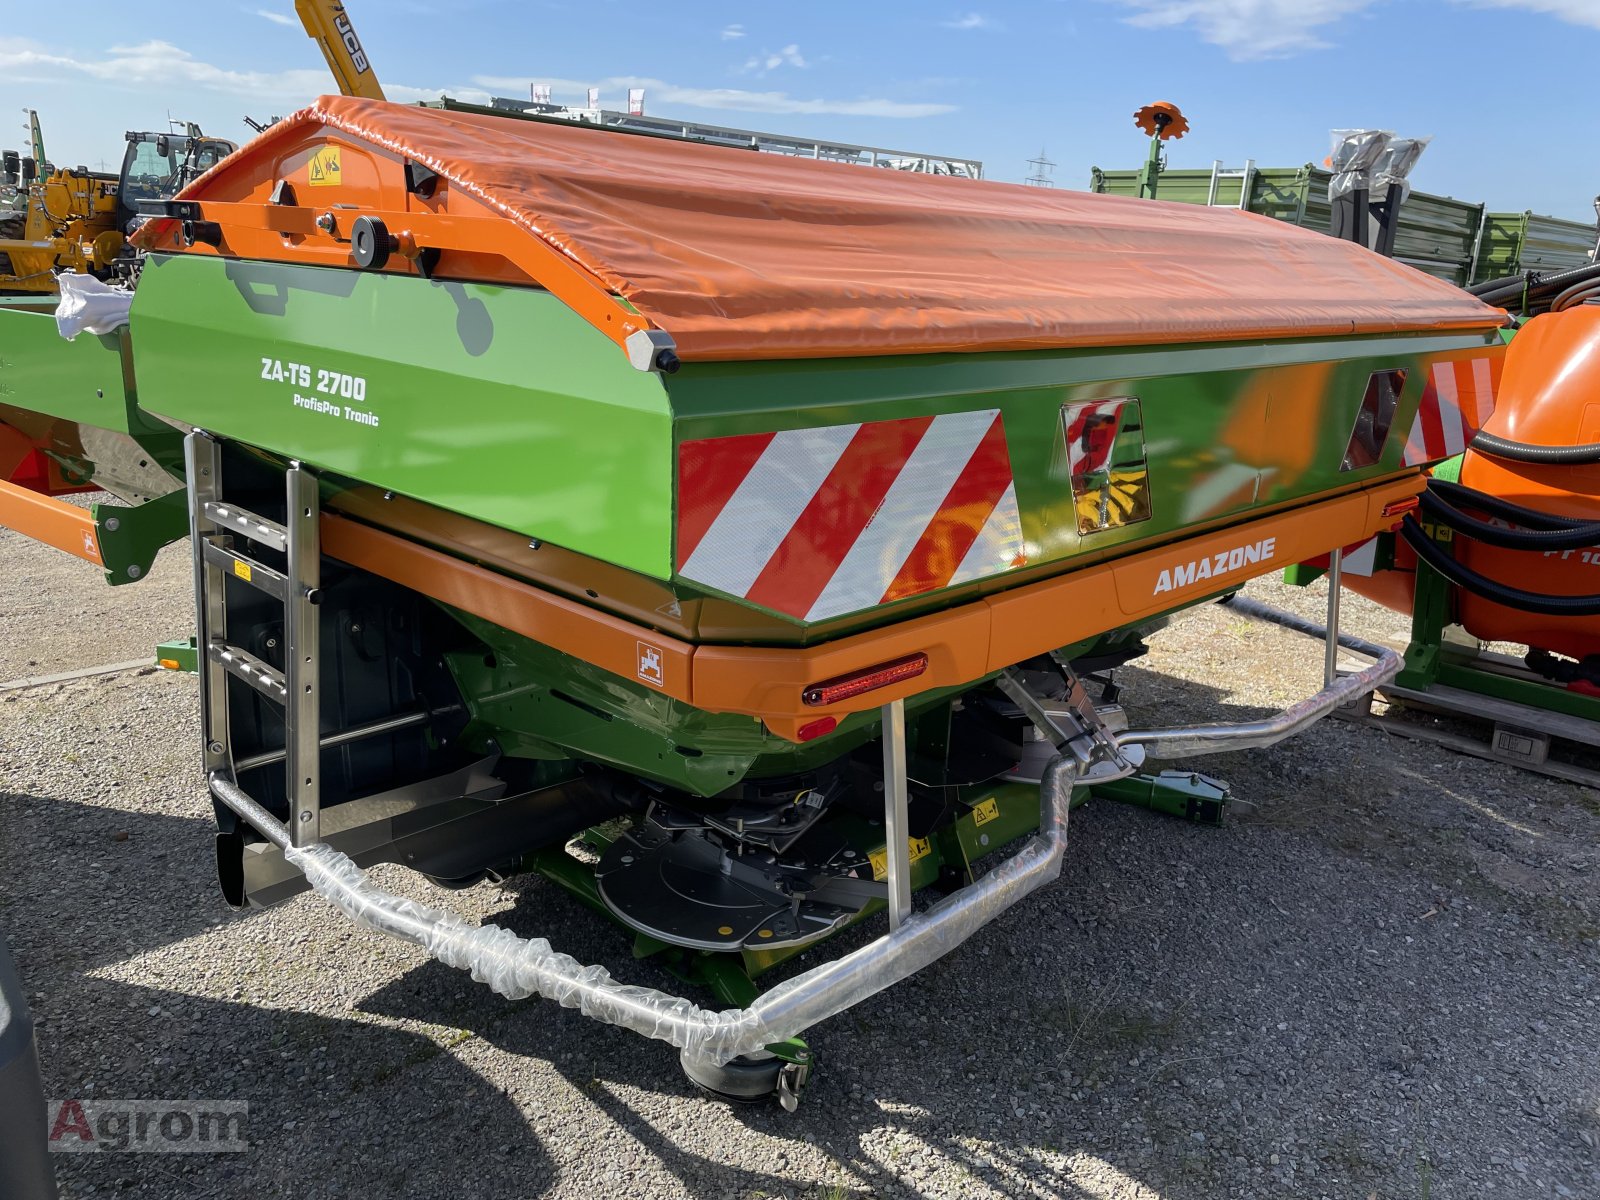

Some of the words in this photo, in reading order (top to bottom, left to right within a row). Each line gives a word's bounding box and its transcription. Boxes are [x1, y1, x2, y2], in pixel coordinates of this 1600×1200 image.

[335, 16, 368, 73] JCB
[104, 184, 118, 196] JC
[261, 357, 311, 388] ZA-TS
[316, 369, 366, 402] 2700
[293, 393, 341, 417] ProfisPro
[344, 406, 379, 427] Tronic
[1153, 537, 1276, 596] AMAZONE
